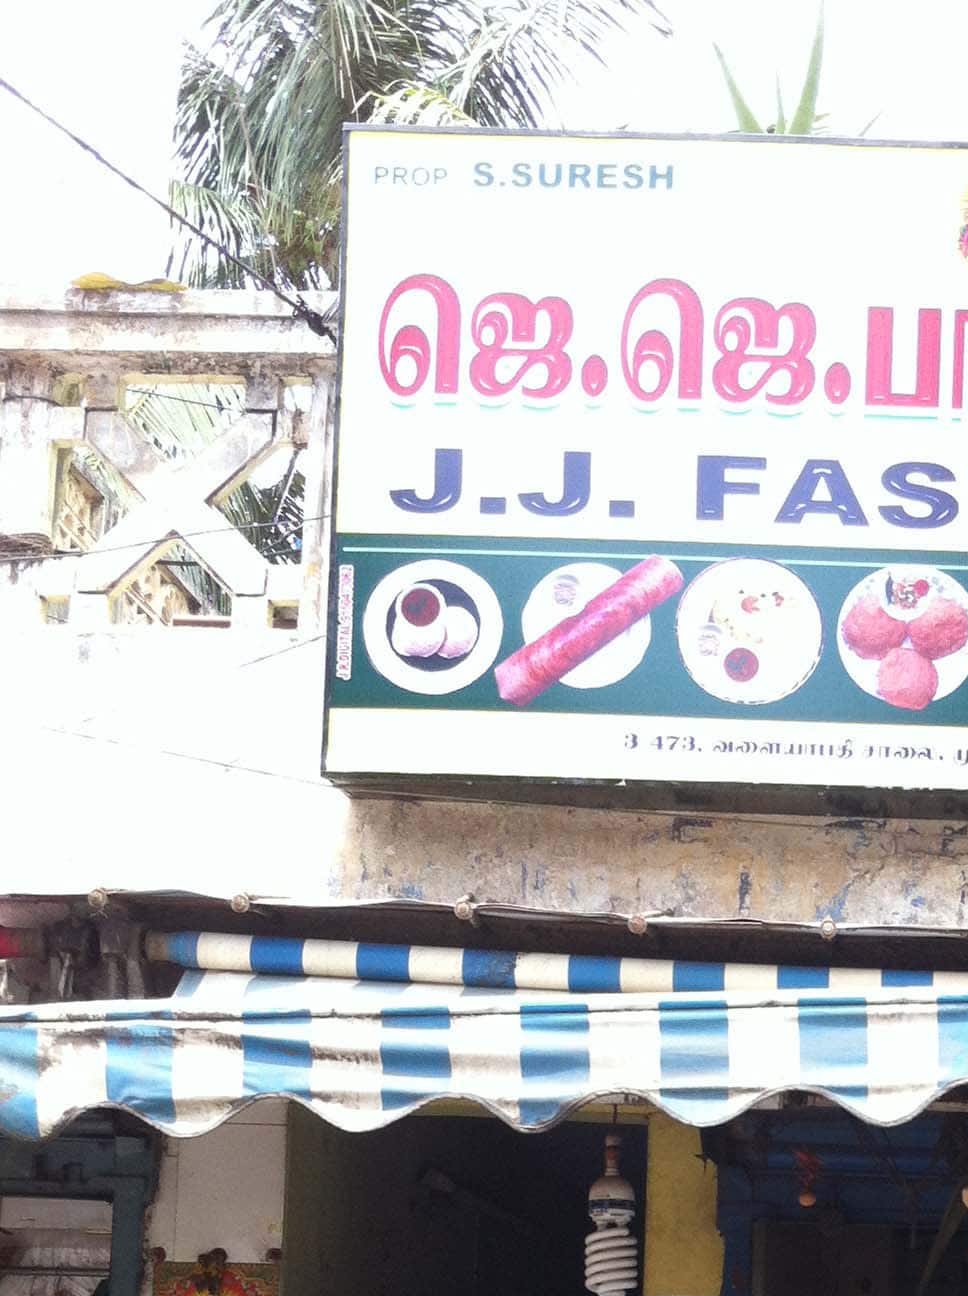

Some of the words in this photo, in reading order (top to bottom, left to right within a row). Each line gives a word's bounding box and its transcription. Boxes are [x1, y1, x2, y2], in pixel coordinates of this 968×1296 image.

[373, 165, 449, 186] PROP
[473, 161, 675, 191] S.SURESH
[389, 448, 636, 519] J.J.
